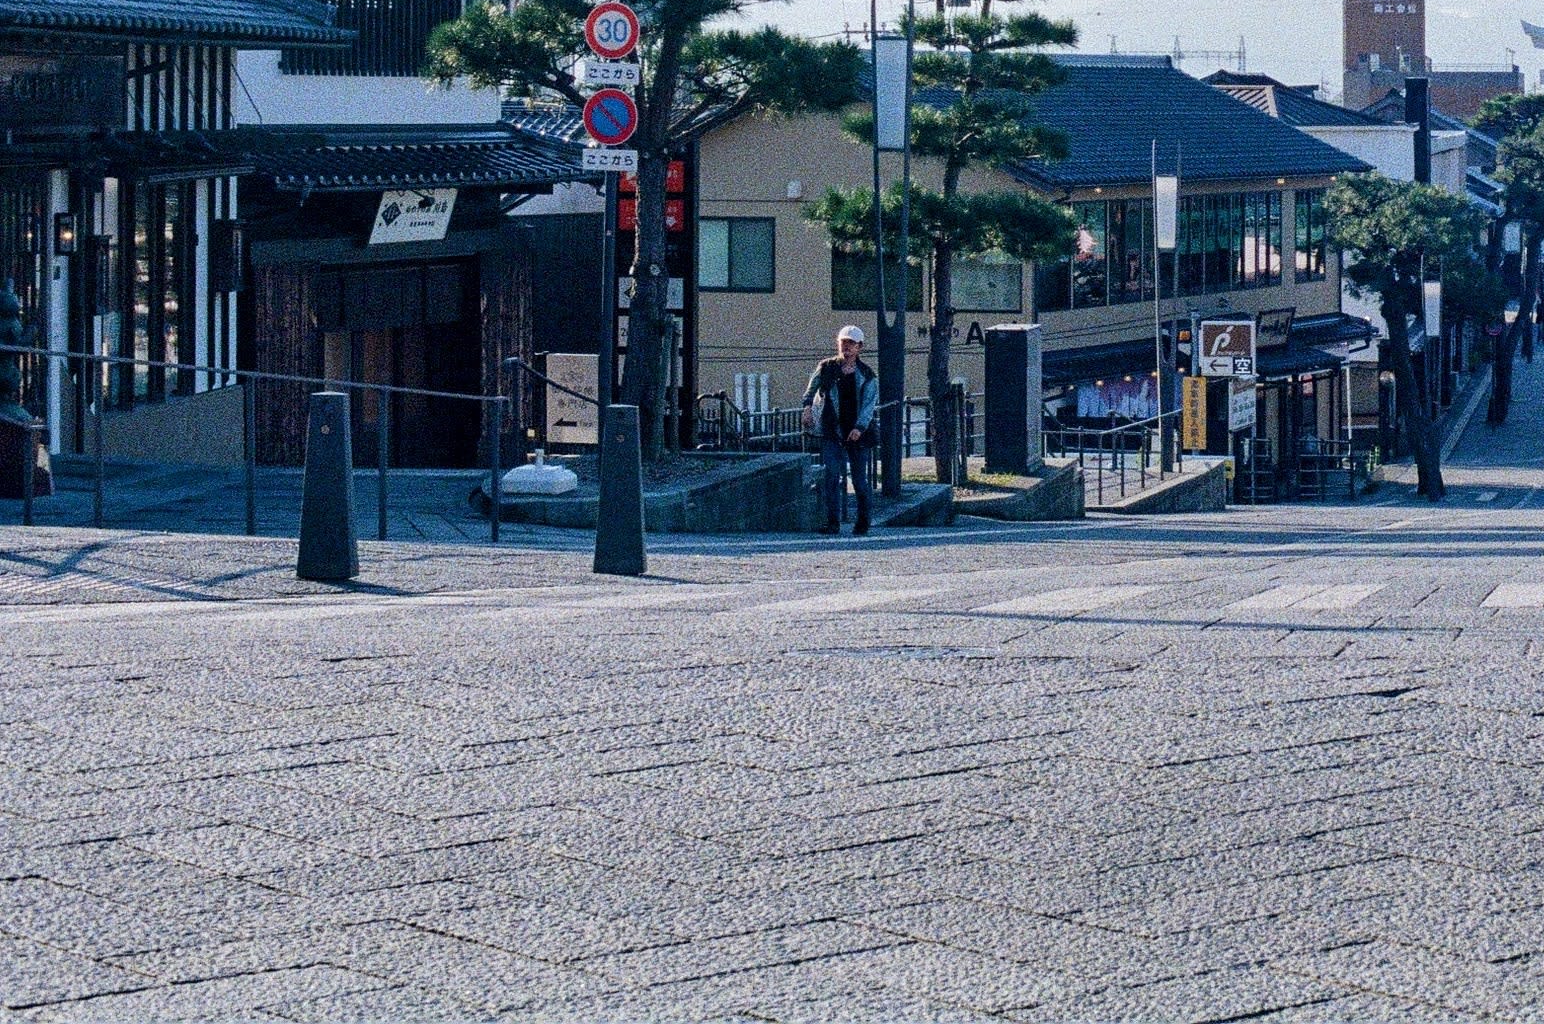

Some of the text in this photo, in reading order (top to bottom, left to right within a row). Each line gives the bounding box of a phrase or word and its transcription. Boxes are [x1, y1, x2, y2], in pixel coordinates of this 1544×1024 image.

[598, 18, 628, 43] 30
[589, 67, 636, 80] ここから
[586, 154, 634, 167] ここから
[1234, 357, 1252, 375] 空
